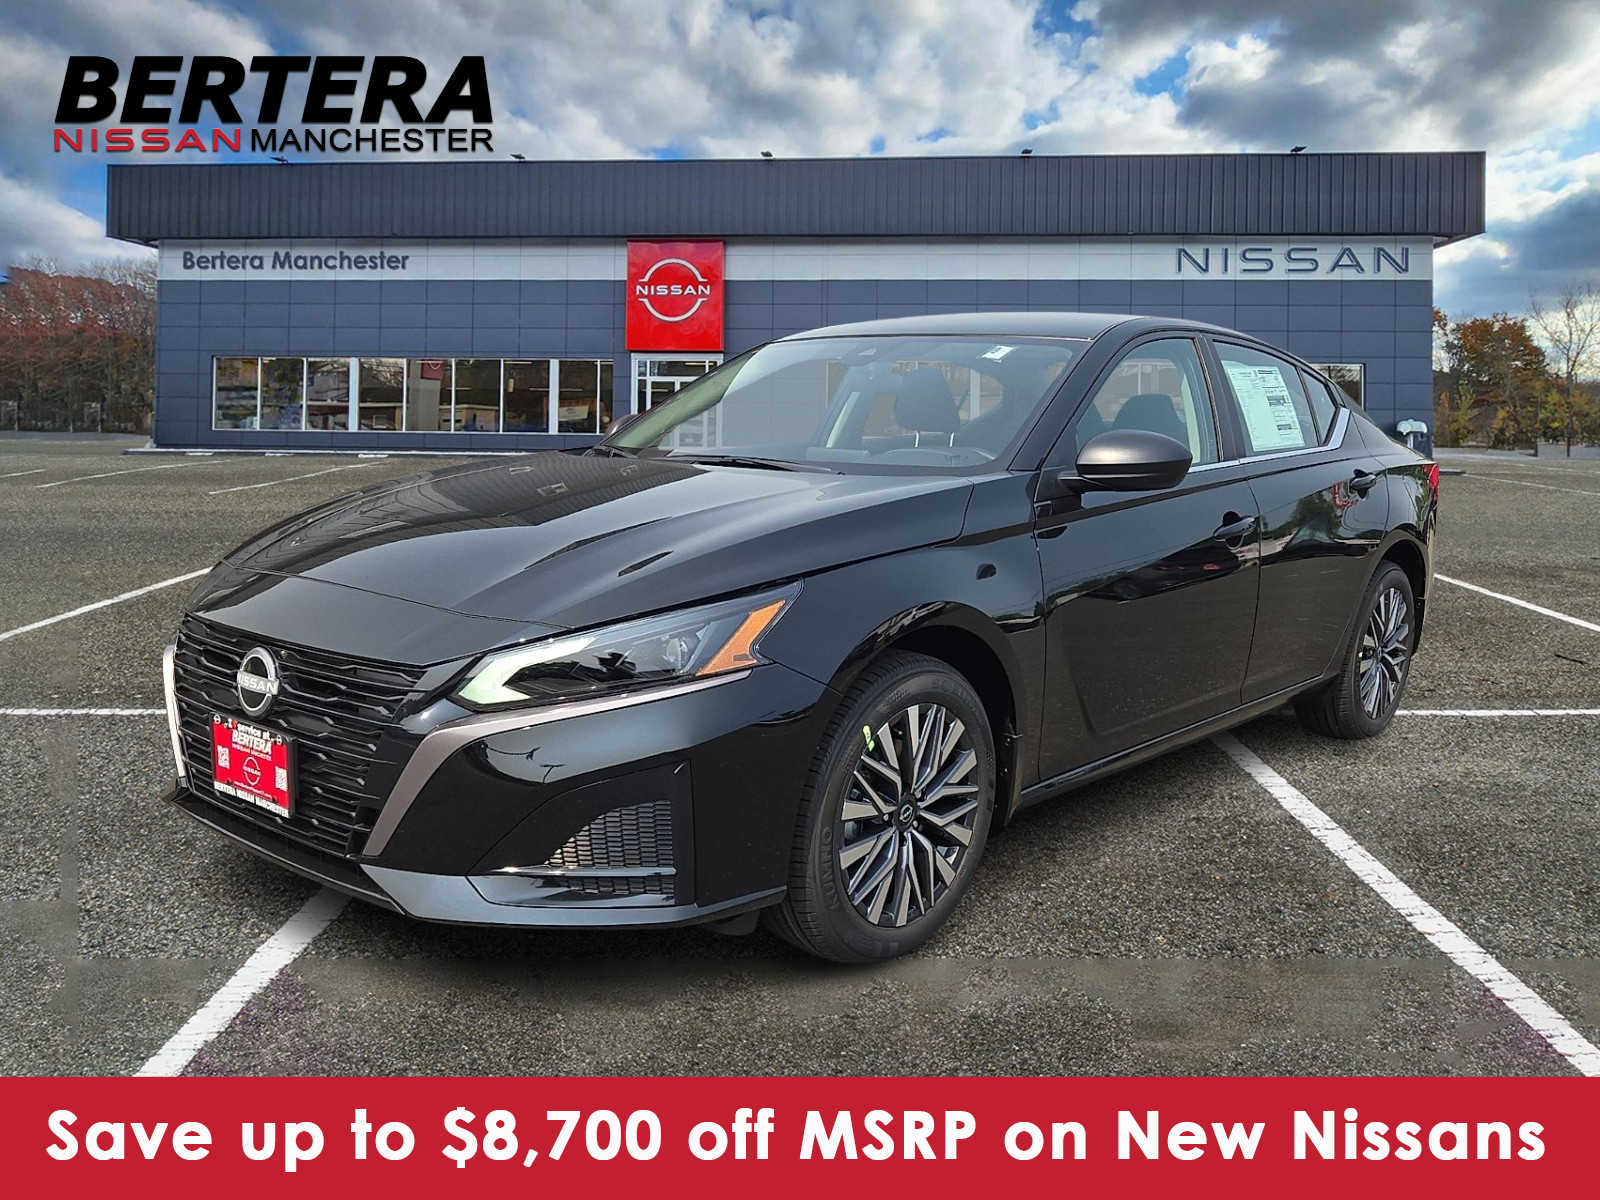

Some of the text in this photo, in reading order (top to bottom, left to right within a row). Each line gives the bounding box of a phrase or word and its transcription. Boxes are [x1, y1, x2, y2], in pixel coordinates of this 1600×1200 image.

[183, 250, 410, 271] Bertera Manchester
[1176, 246, 1410, 274] NISSAN
[635, 284, 711, 296] NISSAN
[232, 729, 272, 755] BERTERA
